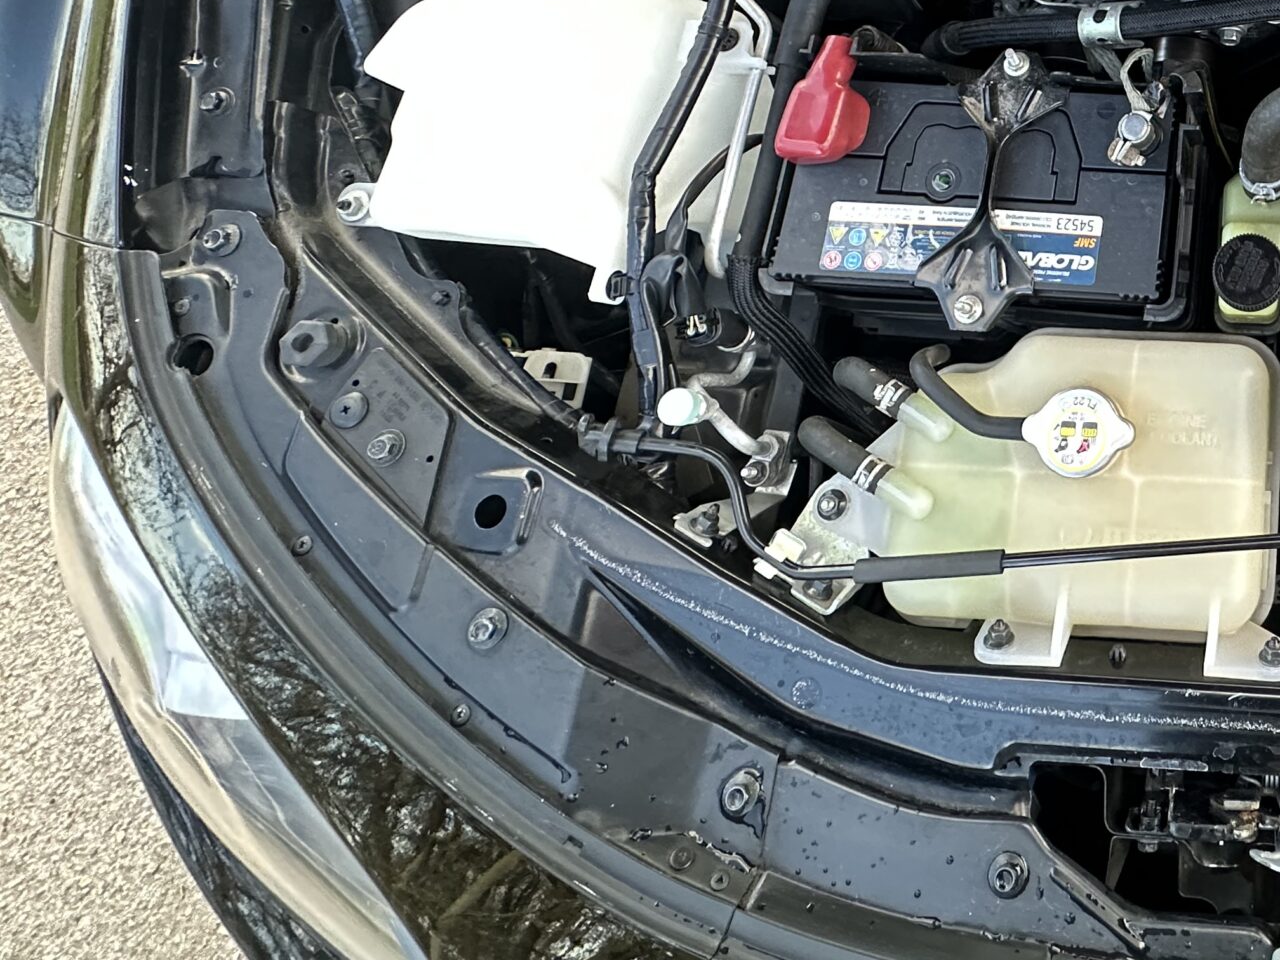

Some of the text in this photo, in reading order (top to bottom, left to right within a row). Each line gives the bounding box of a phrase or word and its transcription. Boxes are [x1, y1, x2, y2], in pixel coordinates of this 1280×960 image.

[1056, 217, 1094, 232] 54523
[1073, 237, 1097, 248] SMF
[1073, 396, 1098, 410] FL22
